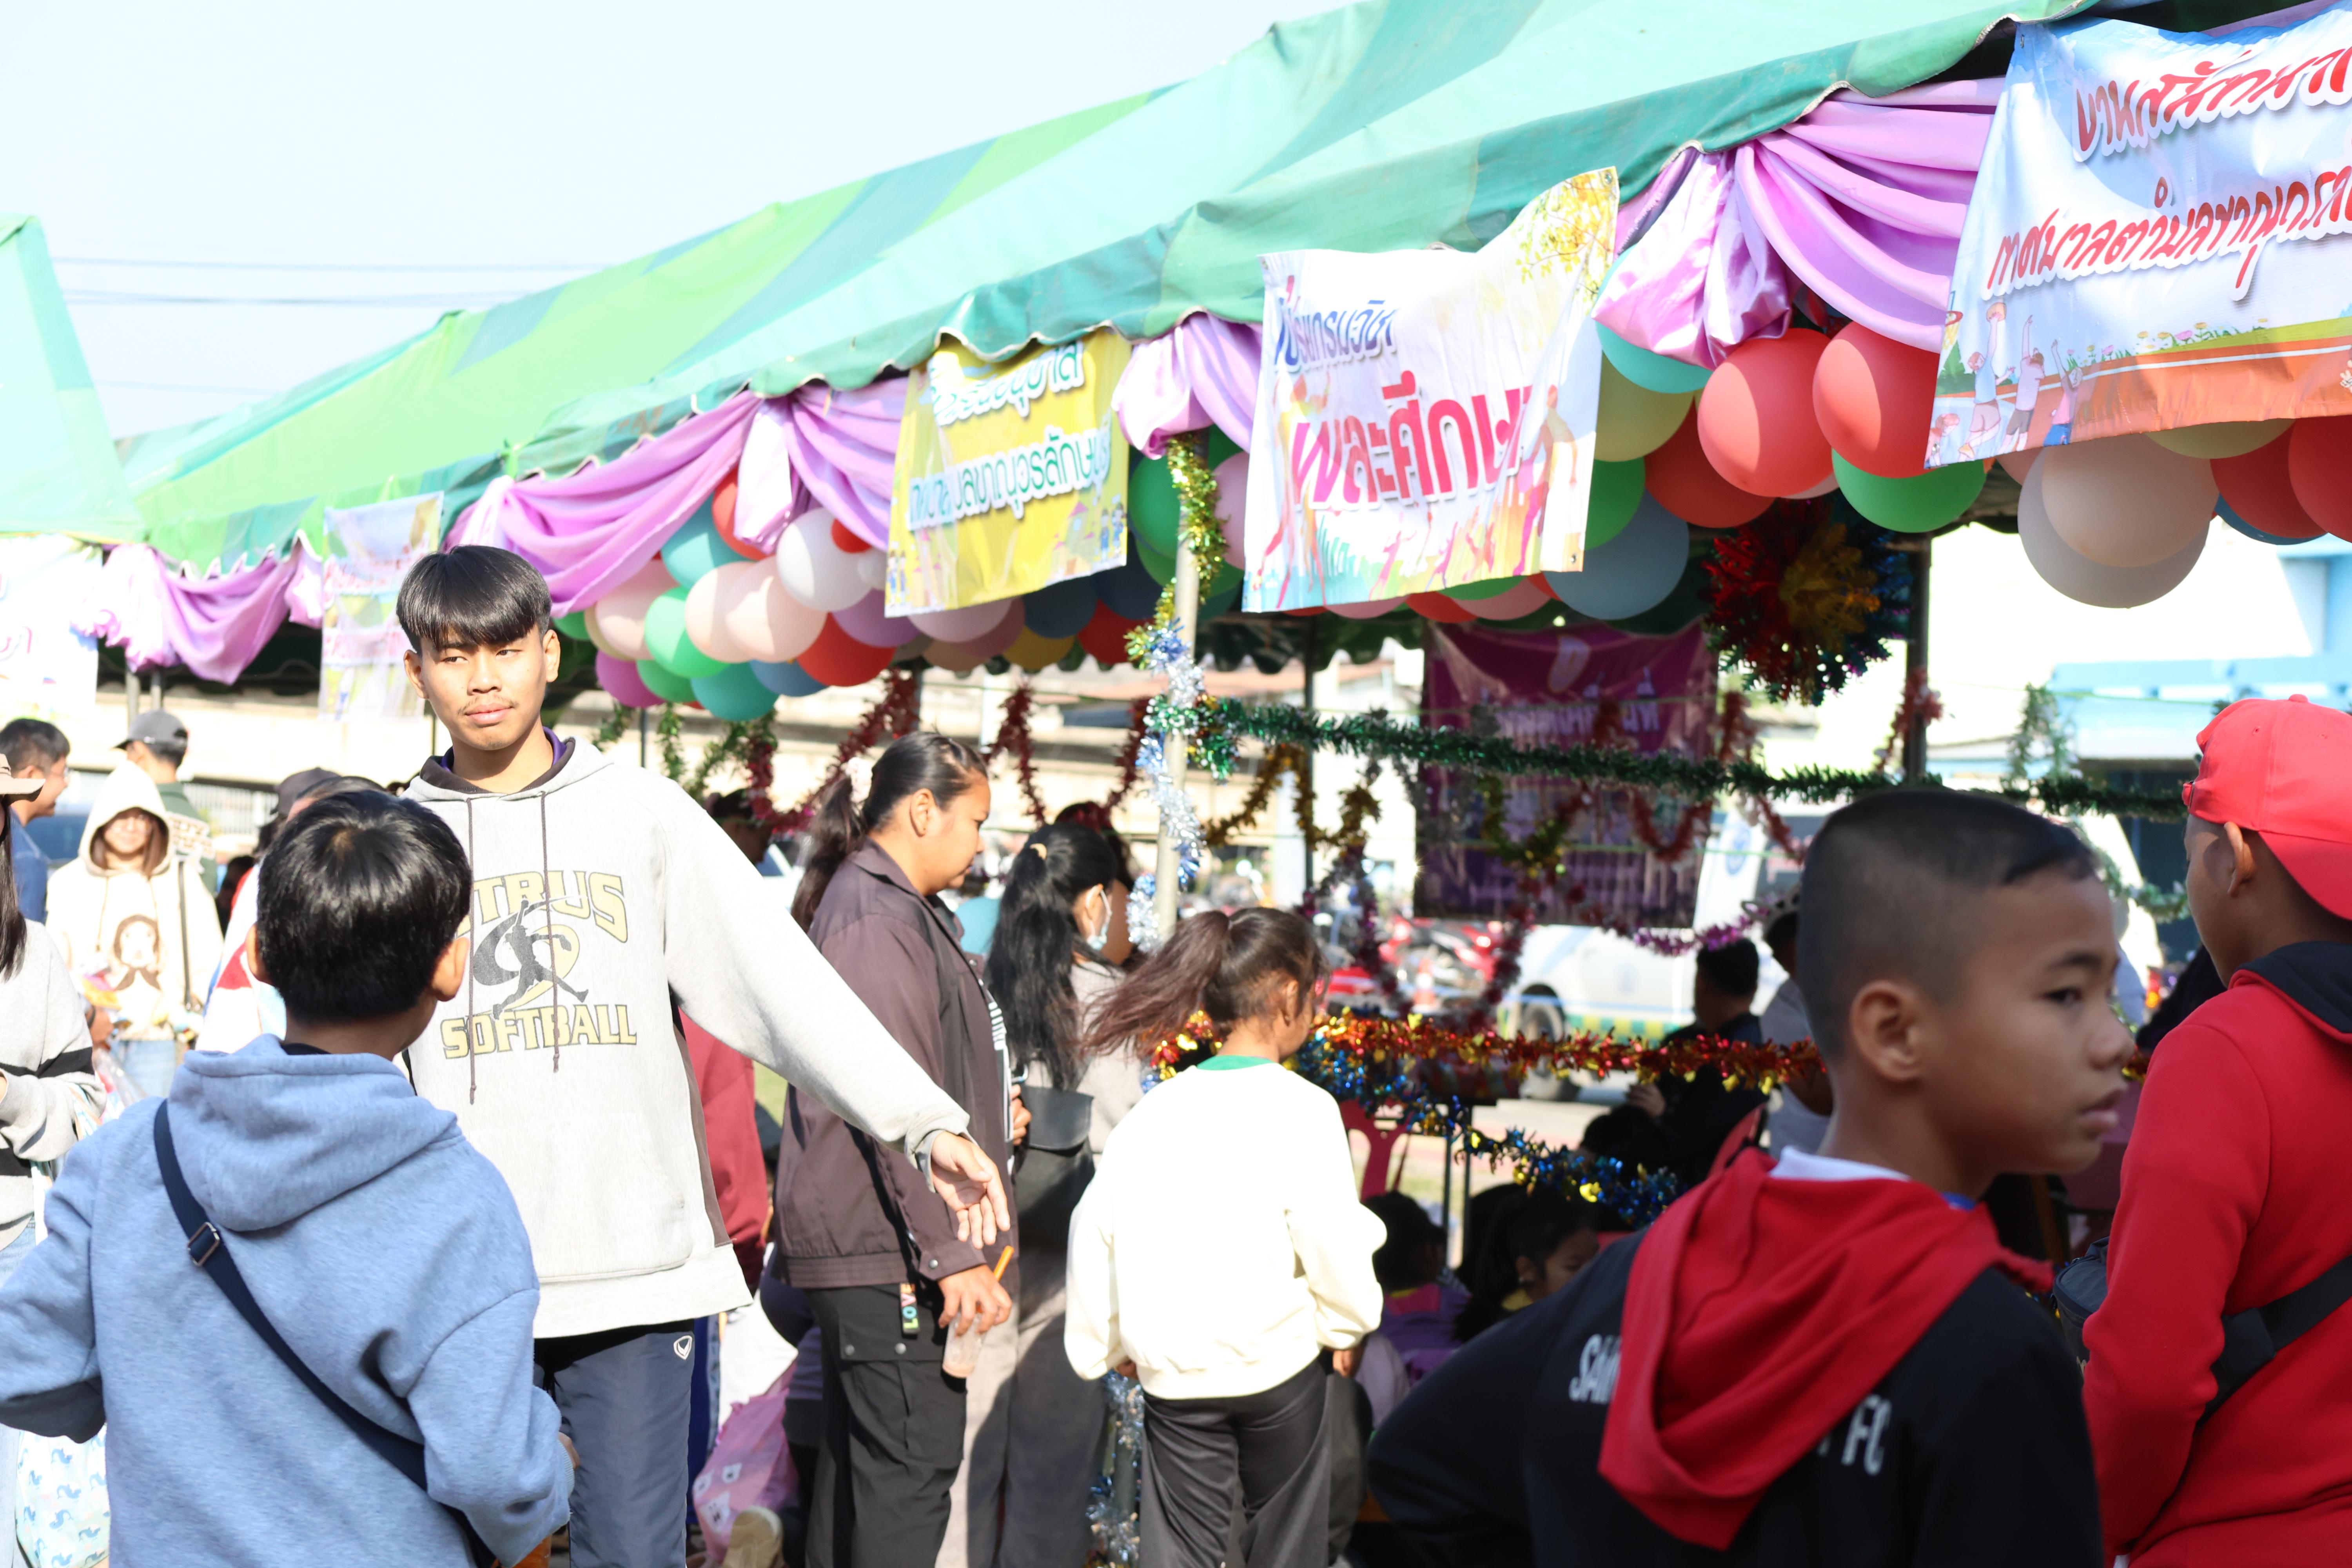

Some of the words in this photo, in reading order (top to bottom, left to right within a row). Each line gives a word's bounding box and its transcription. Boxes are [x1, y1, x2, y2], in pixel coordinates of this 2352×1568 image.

[1987, 165, 2352, 289] เทศบาลตำบลขาณุวรล
[456, 870, 628, 943] TRUS
[440, 1004, 637, 1059] SOFTBALL
[900, 1283, 919, 1329] LOVE
[1841, 1394, 1892, 1477] FC
